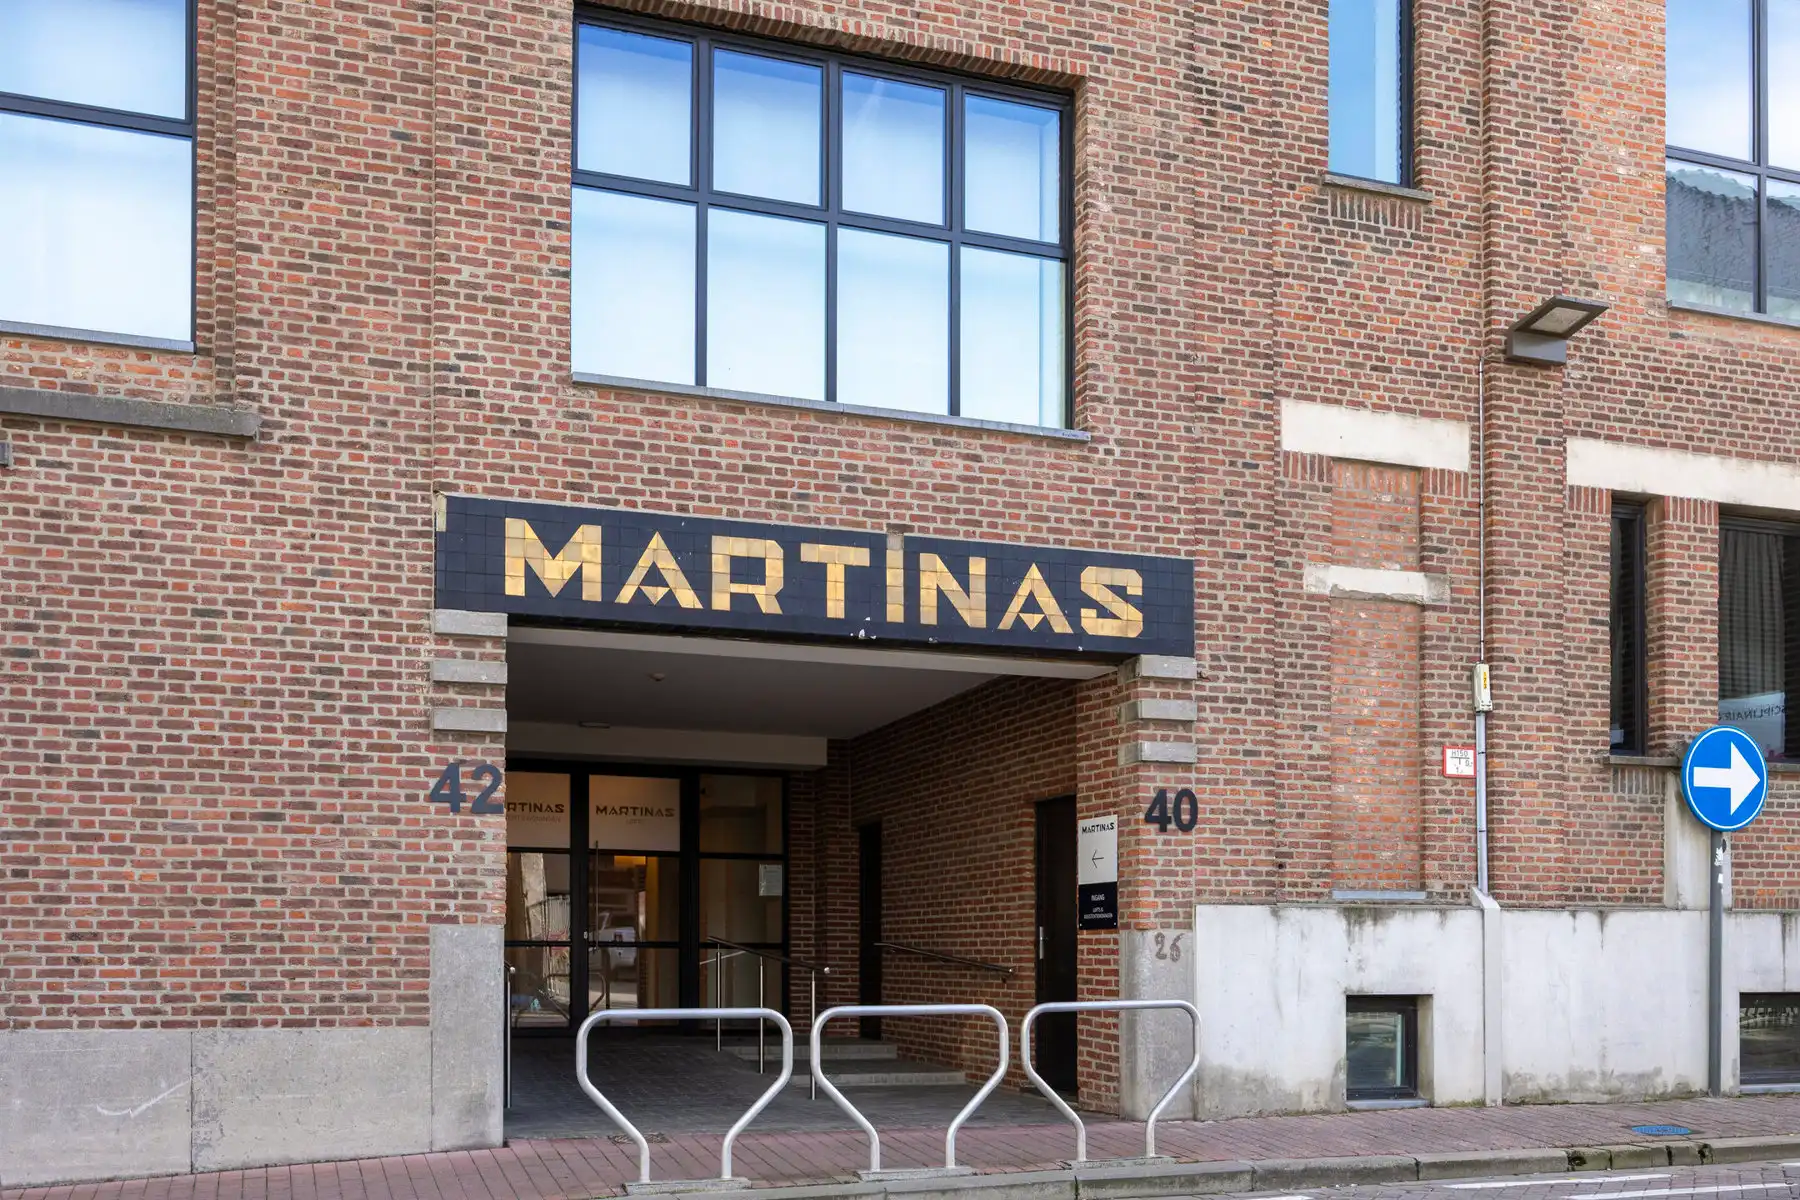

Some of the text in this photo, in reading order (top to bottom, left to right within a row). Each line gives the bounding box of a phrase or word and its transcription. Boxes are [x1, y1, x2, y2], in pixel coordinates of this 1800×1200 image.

[503, 517, 1145, 638] MARTINAS
[429, 762, 504, 814] 42
[507, 802, 565, 813] RTINAS
[595, 804, 676, 817] MARTINAS
[1144, 788, 1199, 833] 40
[1081, 822, 1115, 835] MARTINAS
[1154, 931, 1185, 963] 26
